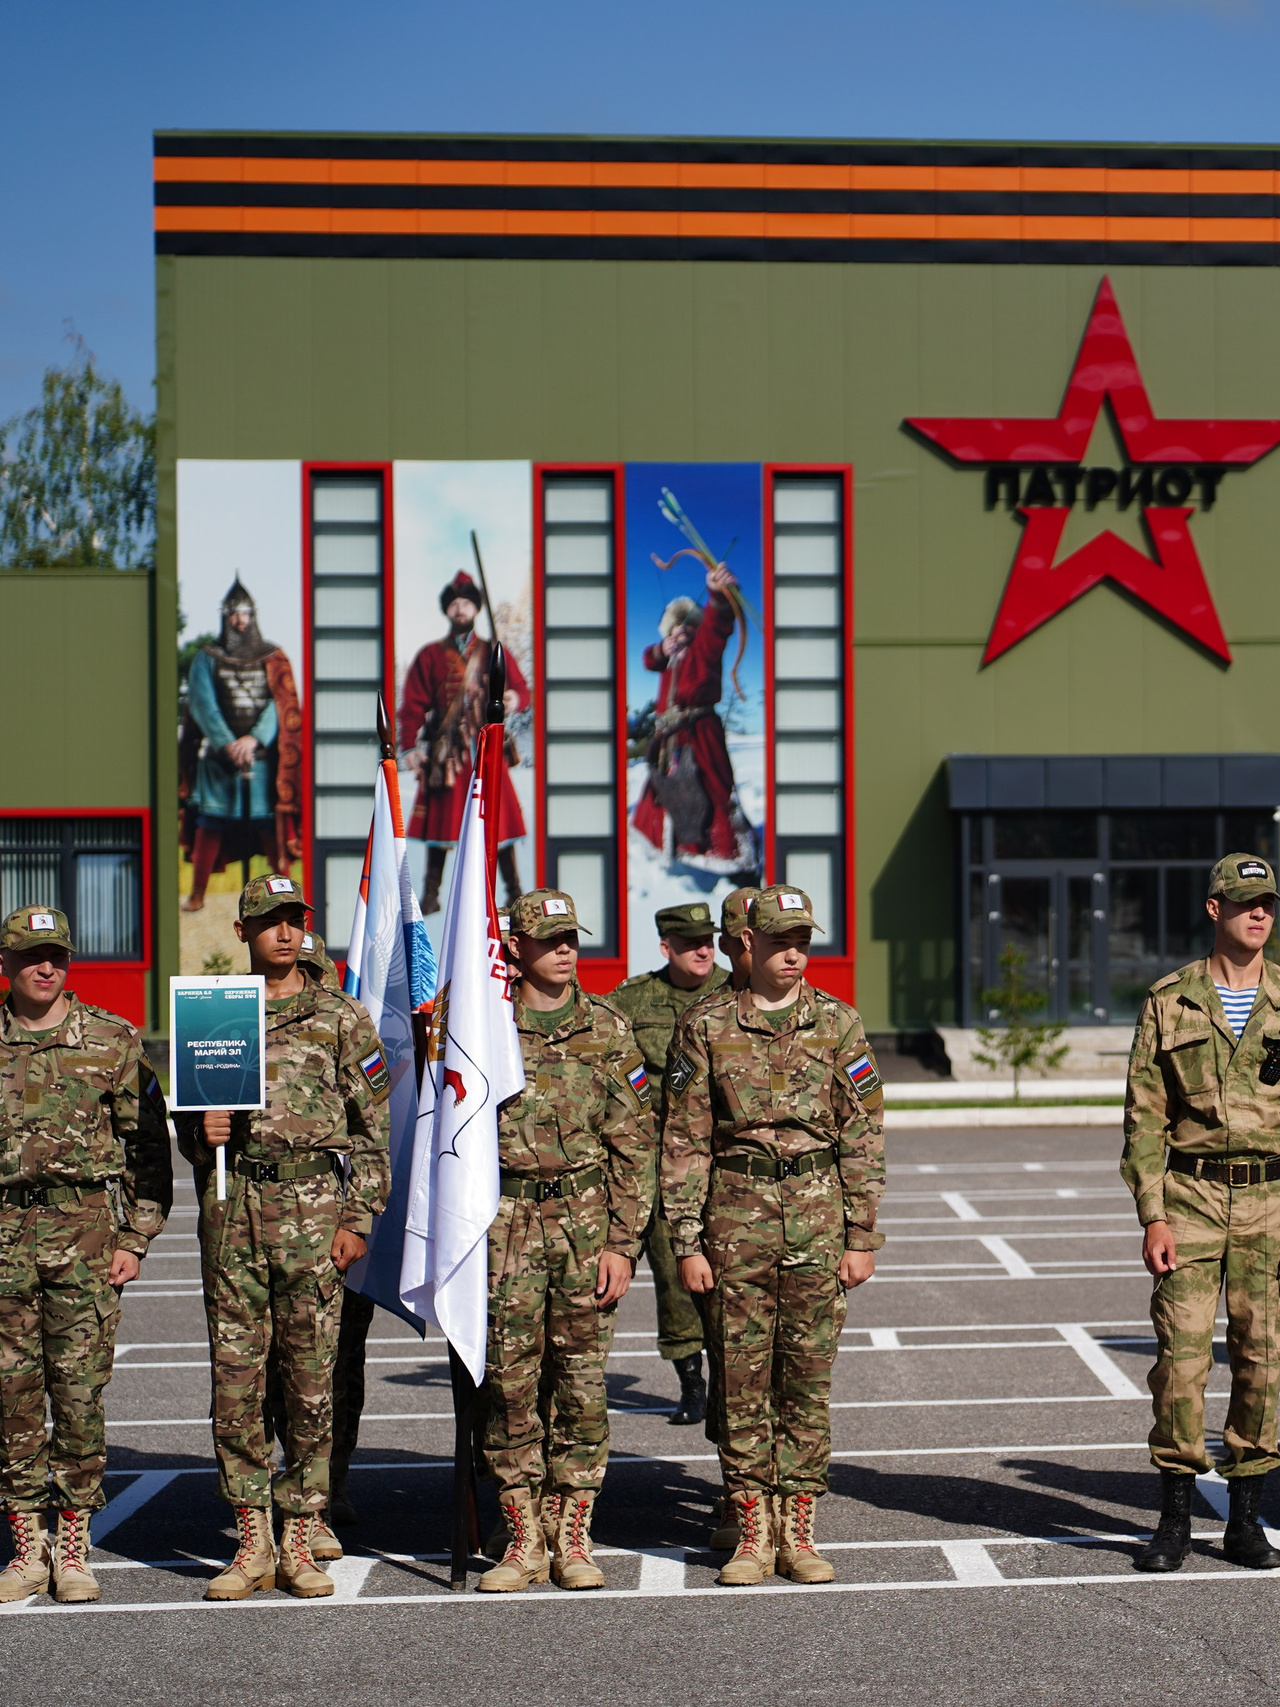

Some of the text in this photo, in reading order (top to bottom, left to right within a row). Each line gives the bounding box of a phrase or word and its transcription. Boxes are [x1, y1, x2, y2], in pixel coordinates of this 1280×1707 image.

[983, 466, 1226, 512] ПАТРИОТ
[187, 1040, 247, 1048] РЕСПУБЛИКА
[194, 1048, 242, 1056] МАРИЙ ЭЛ
